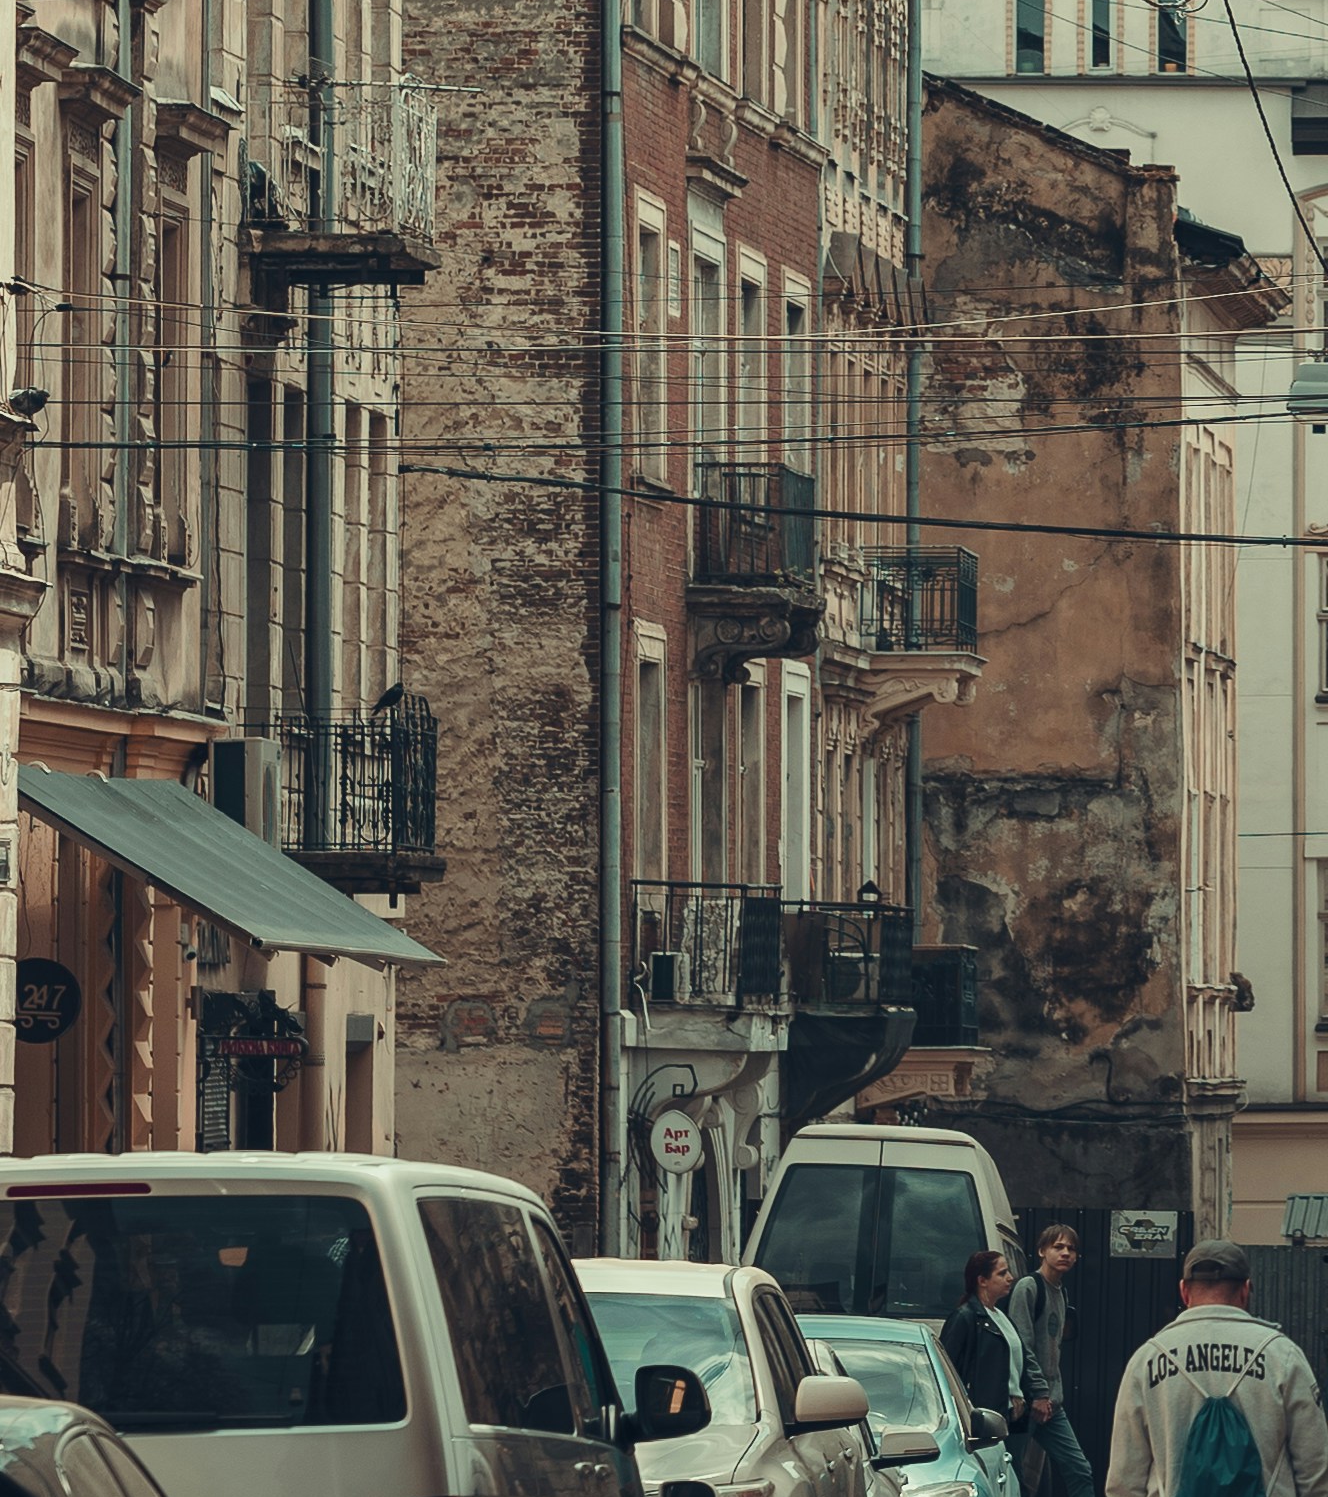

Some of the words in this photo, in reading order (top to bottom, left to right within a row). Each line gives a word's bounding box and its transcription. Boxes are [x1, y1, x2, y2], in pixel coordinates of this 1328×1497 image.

[664, 1127, 690, 1141] Арт
[664, 1143, 690, 1156] Бар
[1147, 1348, 1179, 1389] LOS
[1185, 1343, 1265, 1381] ANGELES
